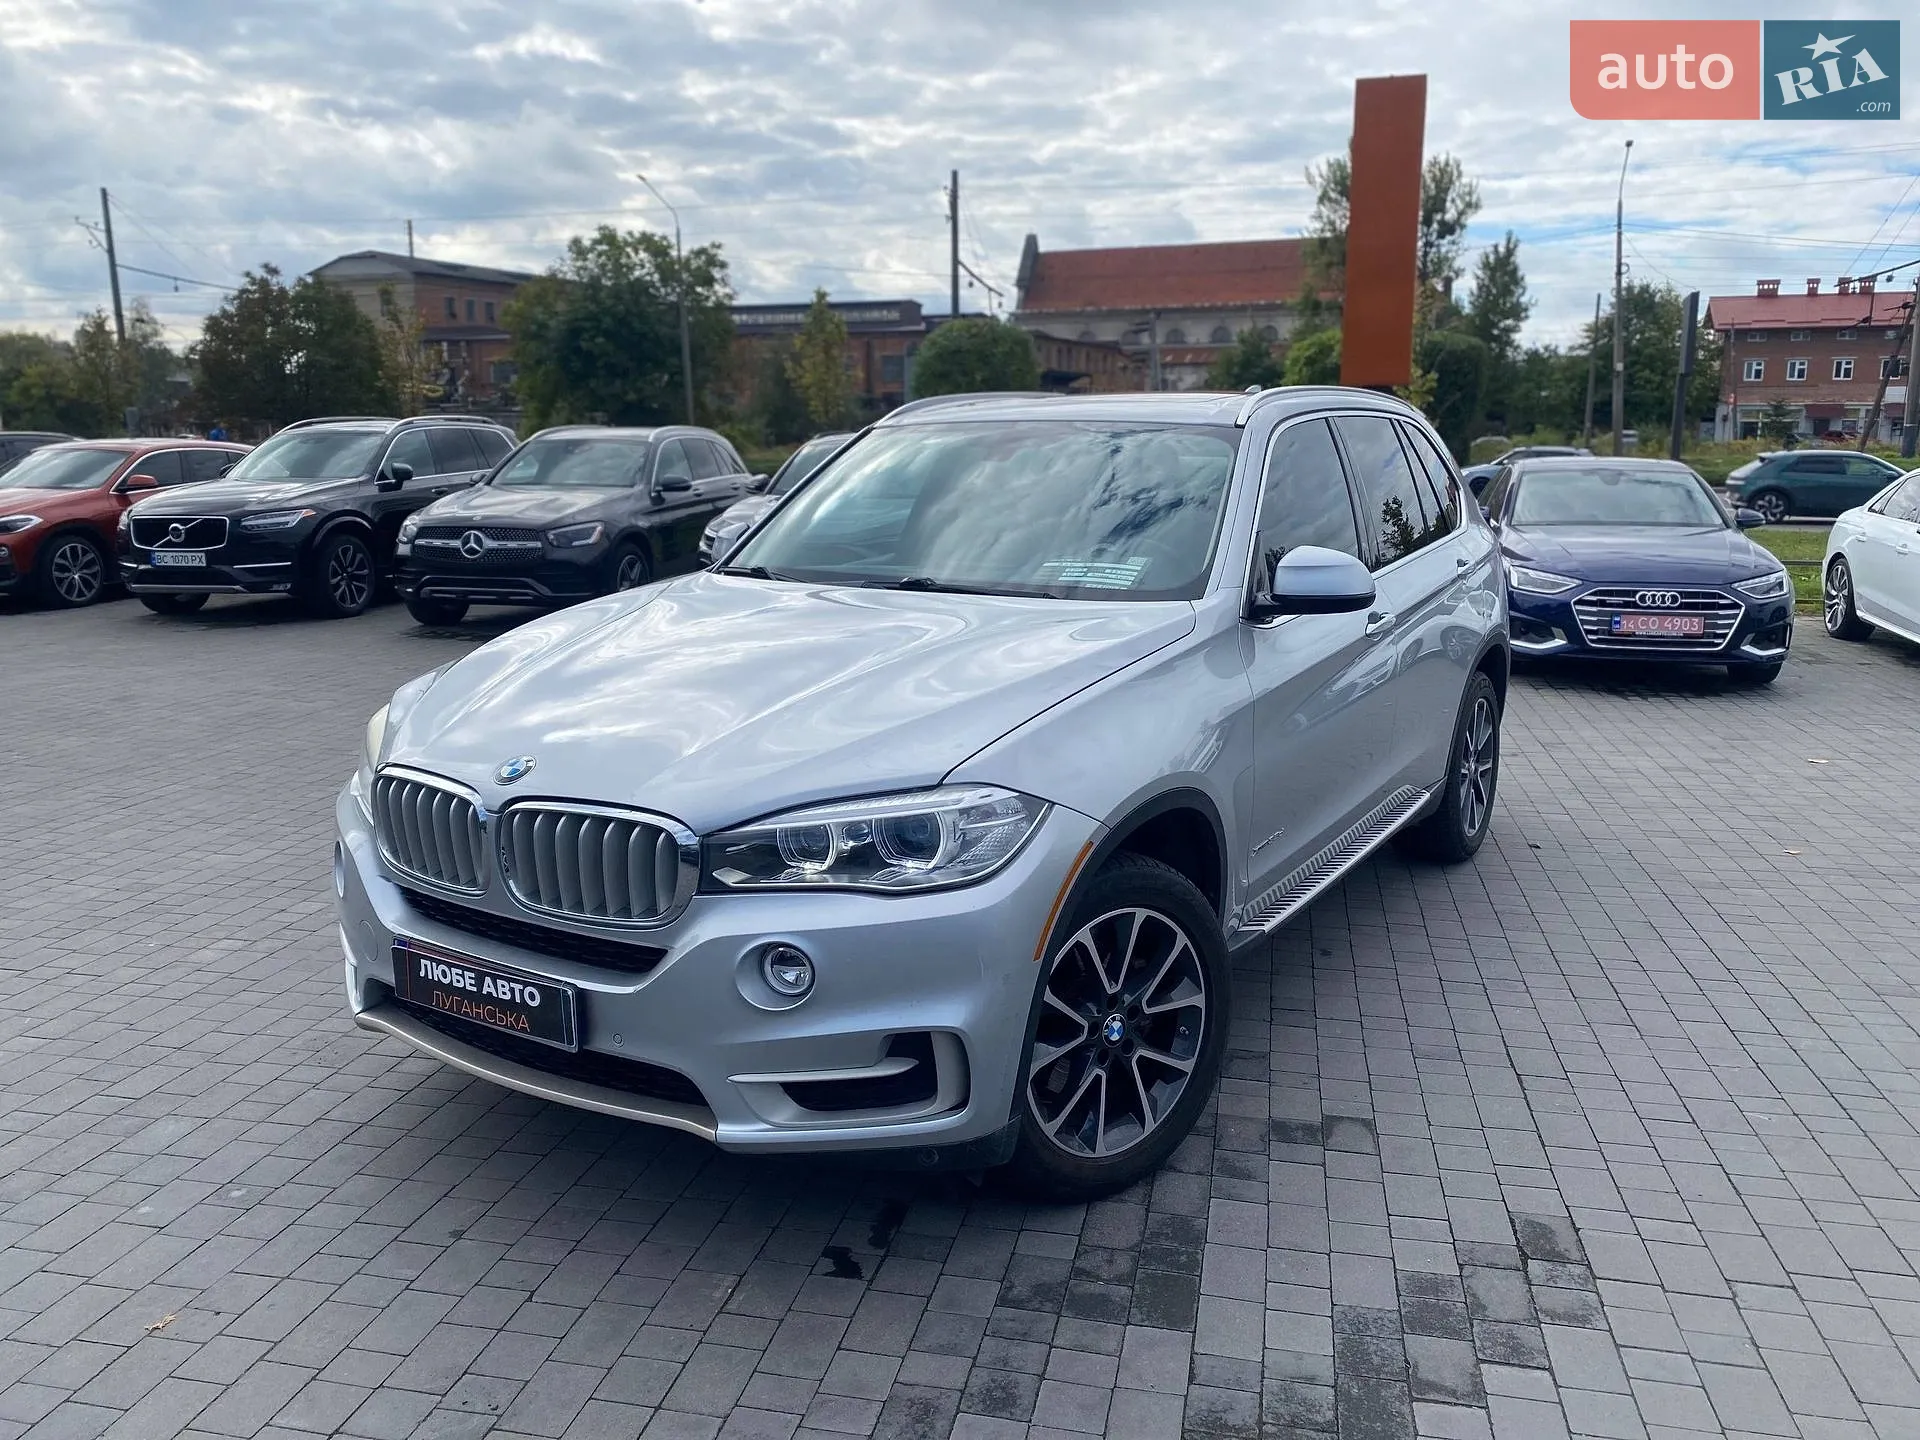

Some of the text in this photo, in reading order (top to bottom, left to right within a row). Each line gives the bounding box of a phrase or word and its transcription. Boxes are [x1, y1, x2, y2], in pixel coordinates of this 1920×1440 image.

[156, 555, 168, 564] BC
[1638, 617, 1659, 629] CO
[1664, 618, 1699, 631] 4903
[419, 958, 541, 1007] ЛЮБЕ АВТО
[432, 990, 531, 1032] ЛУГАНСЬКА
